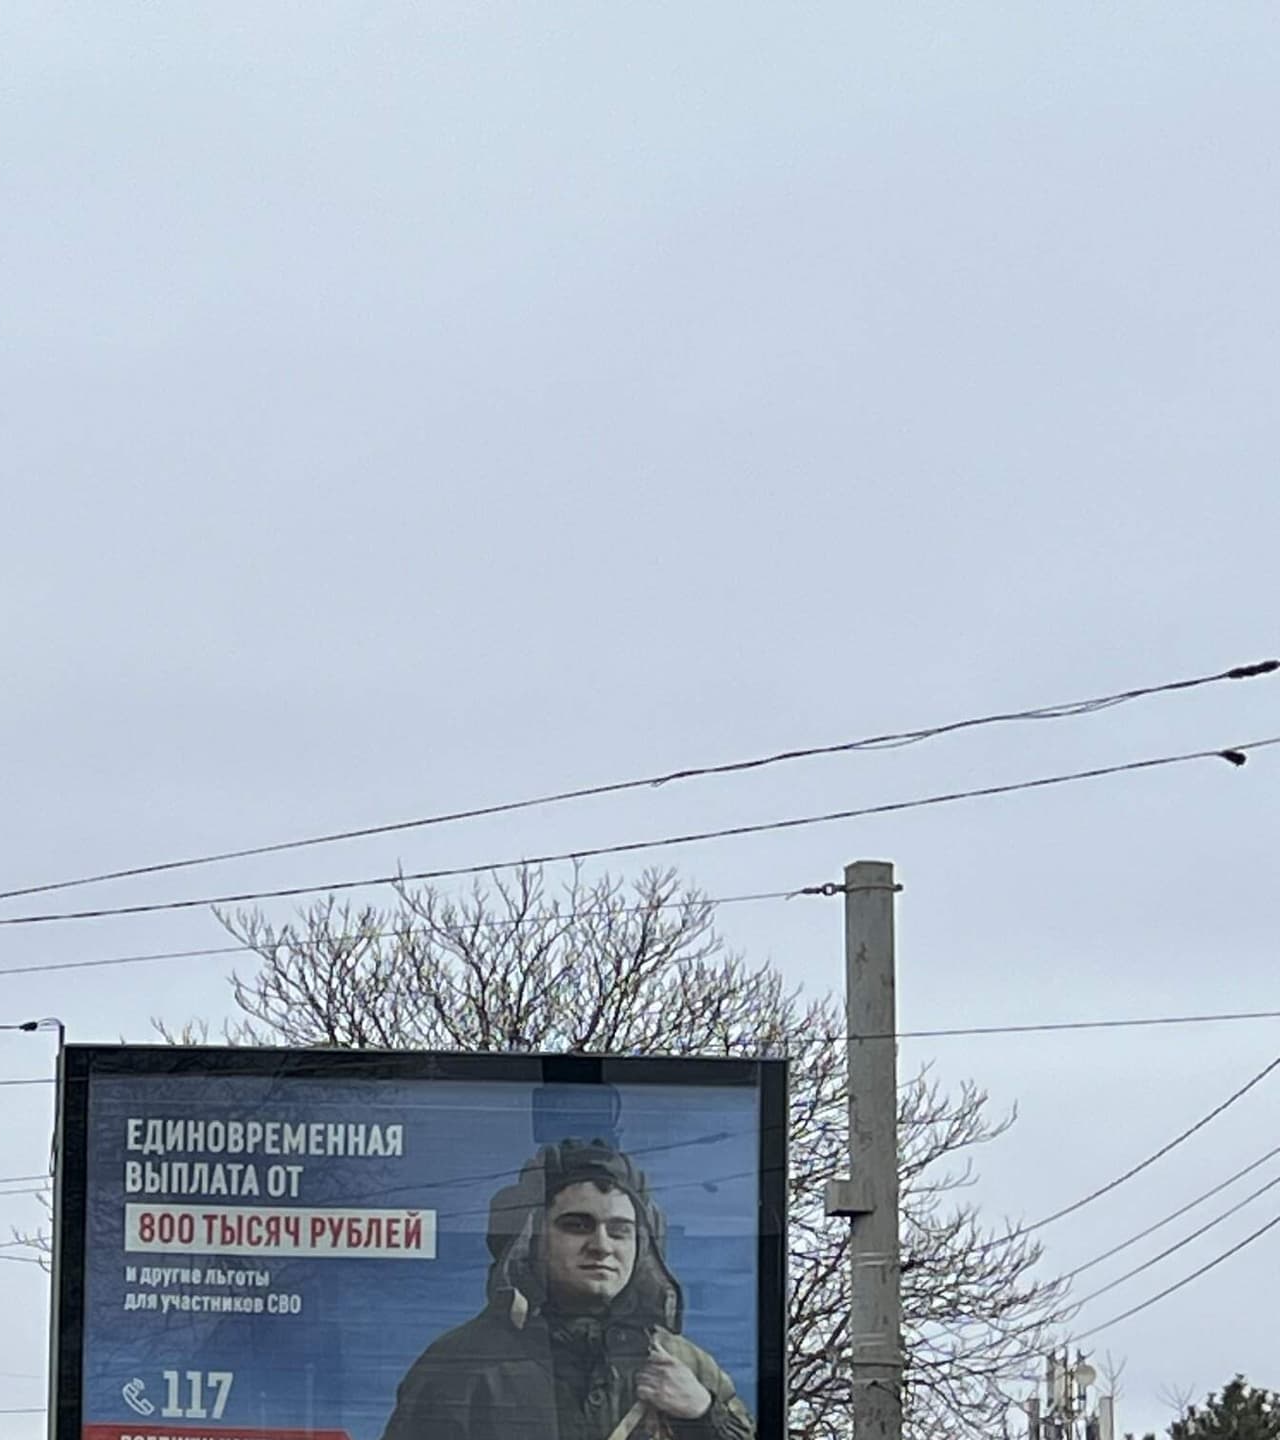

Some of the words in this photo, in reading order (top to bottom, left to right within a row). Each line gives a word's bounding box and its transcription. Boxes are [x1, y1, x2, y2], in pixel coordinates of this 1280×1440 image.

[127, 1118, 404, 1156] ЕДИНОВРЕМЕННАЯ
[125, 1160, 260, 1196] ВЫПЛАТА
[267, 1165, 303, 1197] ОТ
[138, 1212, 195, 1244] 800
[202, 1214, 300, 1247] ТЫСЯЧ
[310, 1211, 422, 1249] РУБЛЕЙ
[126, 1267, 137, 1282] и
[140, 1266, 201, 1287] другие
[205, 1268, 270, 1287] льготы
[124, 1292, 158, 1311] для
[160, 1293, 263, 1314] участников
[267, 1295, 302, 1313] СВО
[161, 1370, 234, 1419] 117
